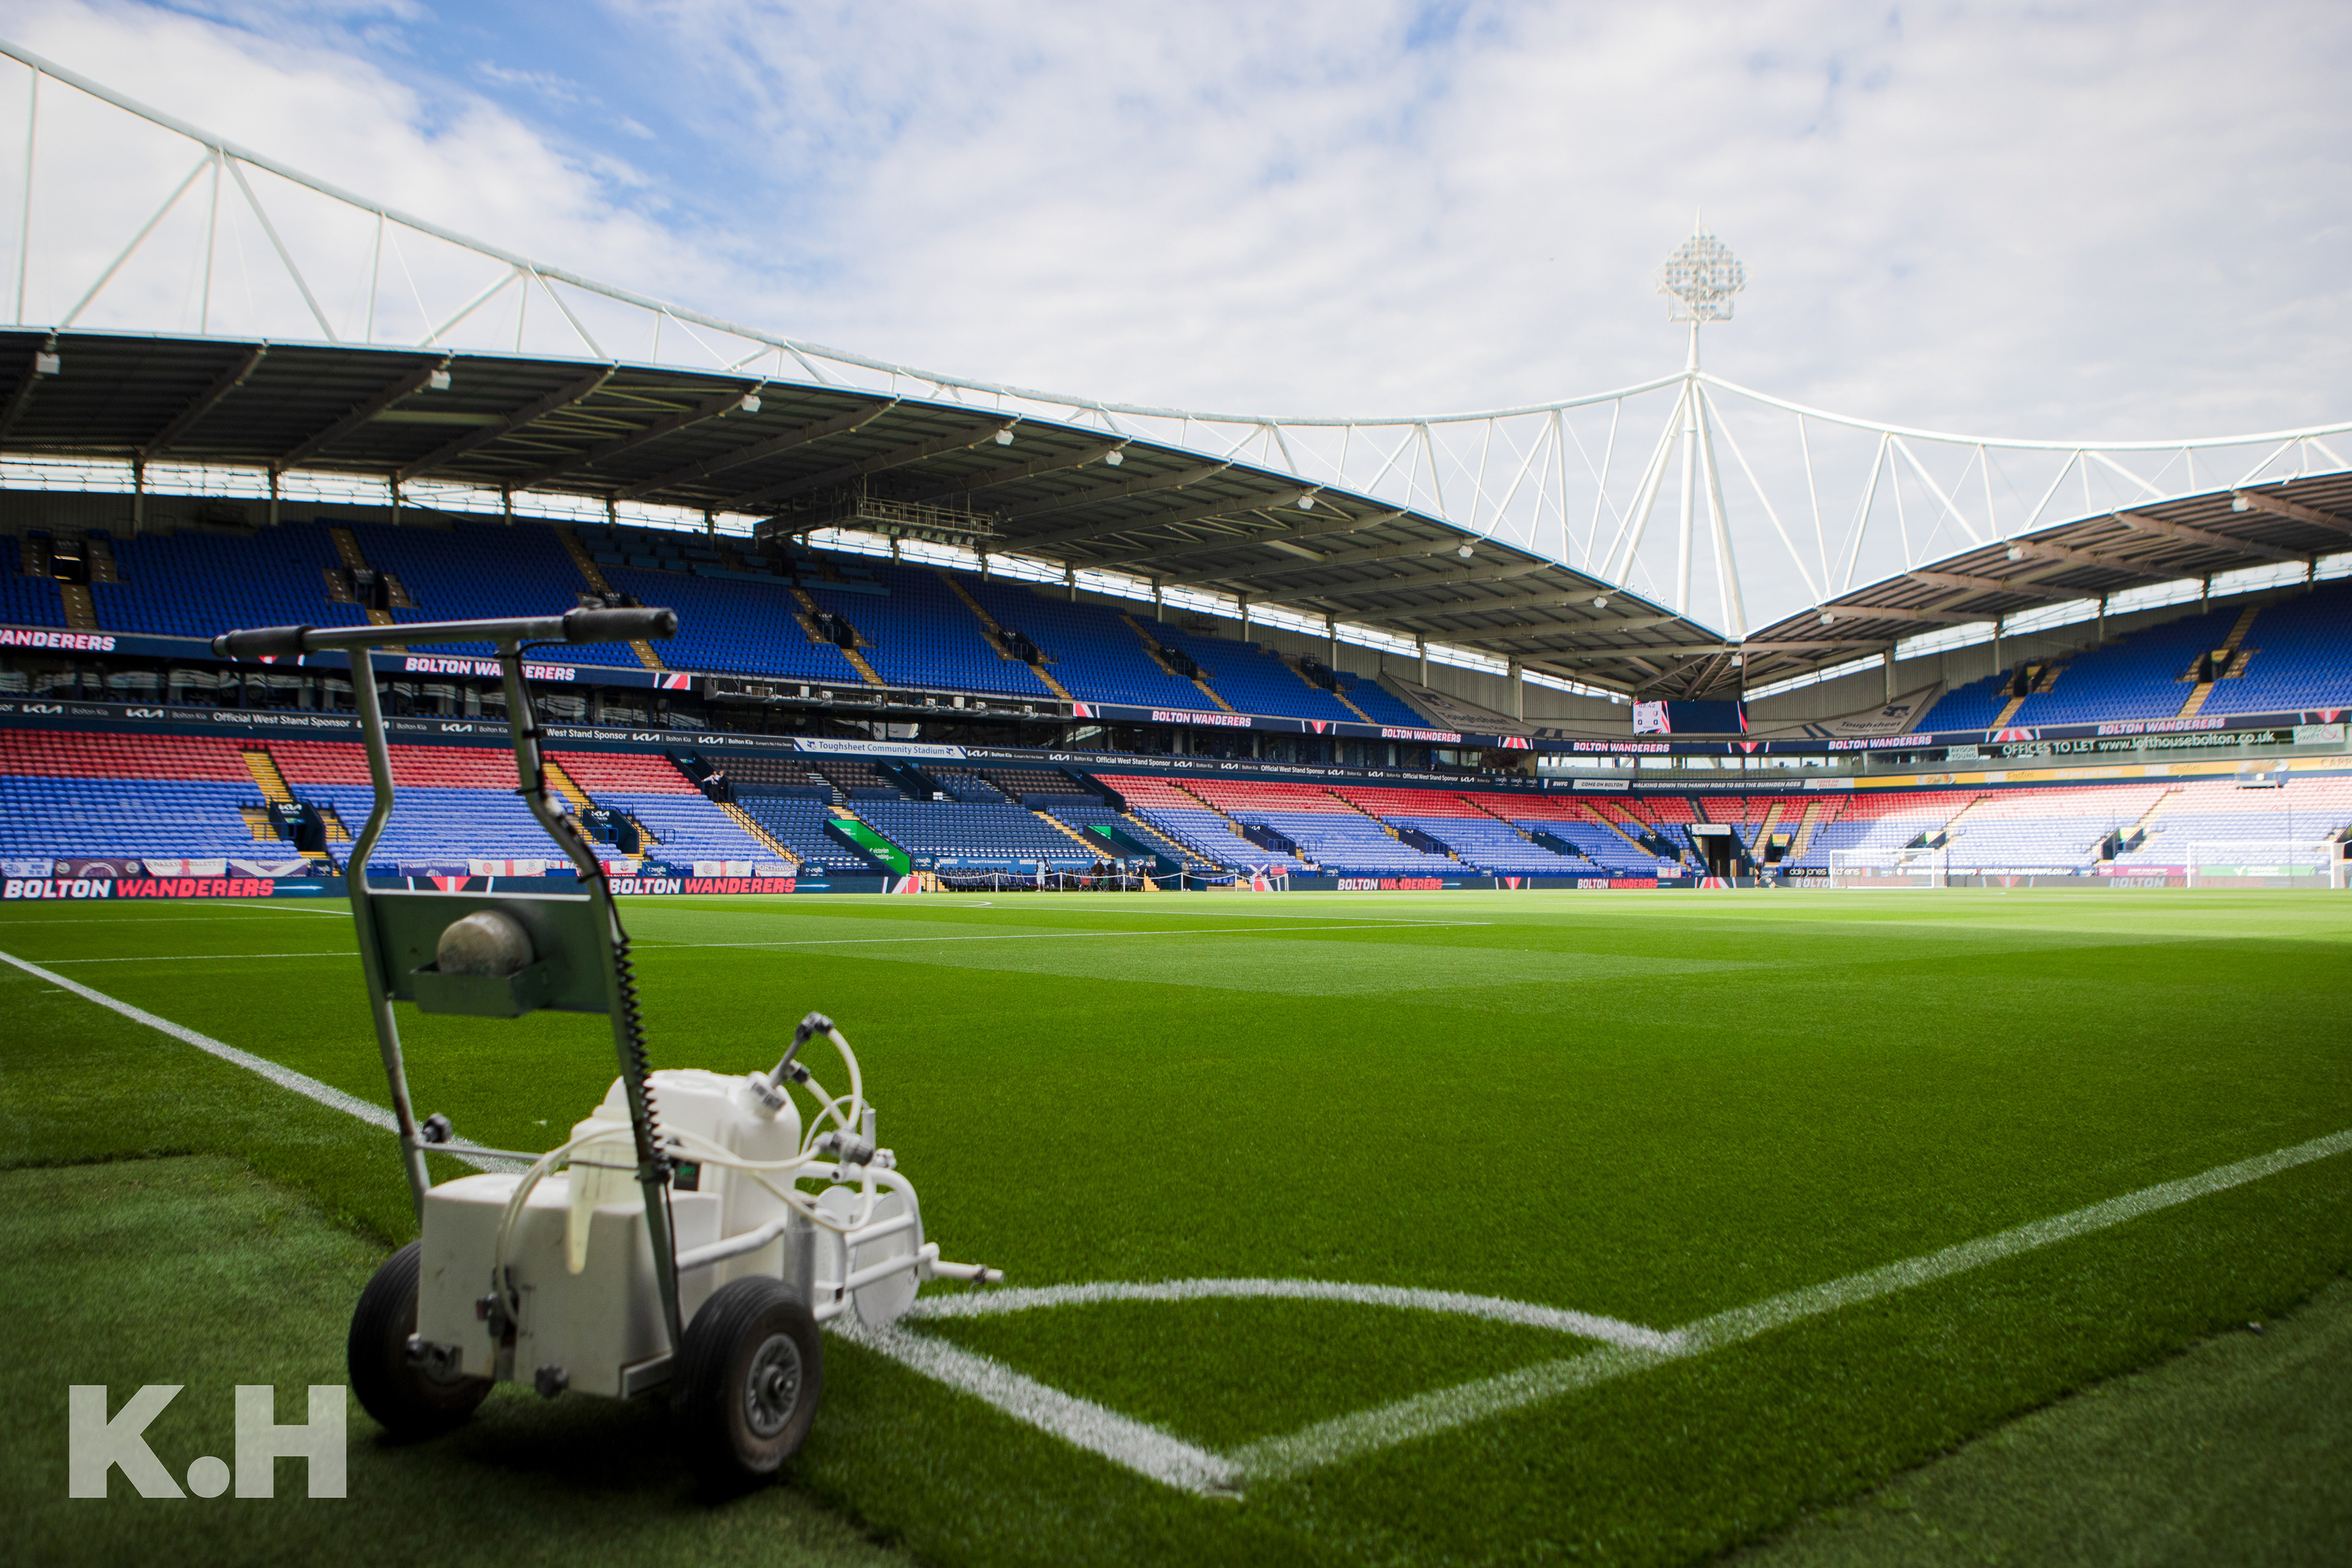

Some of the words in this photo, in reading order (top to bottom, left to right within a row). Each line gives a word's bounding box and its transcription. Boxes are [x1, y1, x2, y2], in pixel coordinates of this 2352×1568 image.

[0, 630, 116, 651] ANDERERS
[405, 657, 472, 674] BOLTON
[474, 662, 576, 681] WAERERS
[213, 711, 251, 723] Official
[252, 714, 278, 725] West
[279, 715, 309, 726] Stand
[311, 717, 351, 728] Sponsor
[1152, 710, 1191, 723] BOLTON
[1192, 713, 1252, 728] WANDERERS
[546, 728, 567, 738] West
[568, 729, 592, 739] Stand
[594, 731, 627, 741] Sponsor
[2097, 722, 2145, 736] BOLTON
[2146, 718, 2226, 734] WANDERERS
[1382, 728, 1413, 739] BOLTON
[1414, 731, 1461, 743] WANDERERS
[818, 741, 865, 752] Toughsheet
[867, 744, 913, 755] Community
[913, 746, 944, 755] Stadium
[1573, 742, 1608, 752] BOLTON
[1610, 742, 1670, 753] WANDERERS
[1828, 739, 1869, 751] BOLTON
[1870, 736, 1933, 748] WANDERERS
[2002, 743, 2051, 755] OFFICES
[2052, 742, 2071, 753] TO
[2073, 740, 2096, 752] LET
[1096, 755, 1117, 764] Official
[1132, 758, 1148, 766] Stand
[1148, 759, 1171, 768] Sponsor
[2007, 770, 2035, 779] Pasties
[1789, 867, 1805, 876] dale
[1806, 867, 1827, 878] jones
[3, 879, 112, 899] BOLTON
[116, 878, 275, 898] WANDERERS
[609, 878, 682, 894] BOLTON
[685, 878, 796, 894] WANDERERS
[1338, 878, 1379, 891] BOLTON
[1380, 878, 1443, 890] WANDERERS
[1577, 878, 1609, 889] BOLTON
[1610, 878, 1658, 889] WANDERERS
